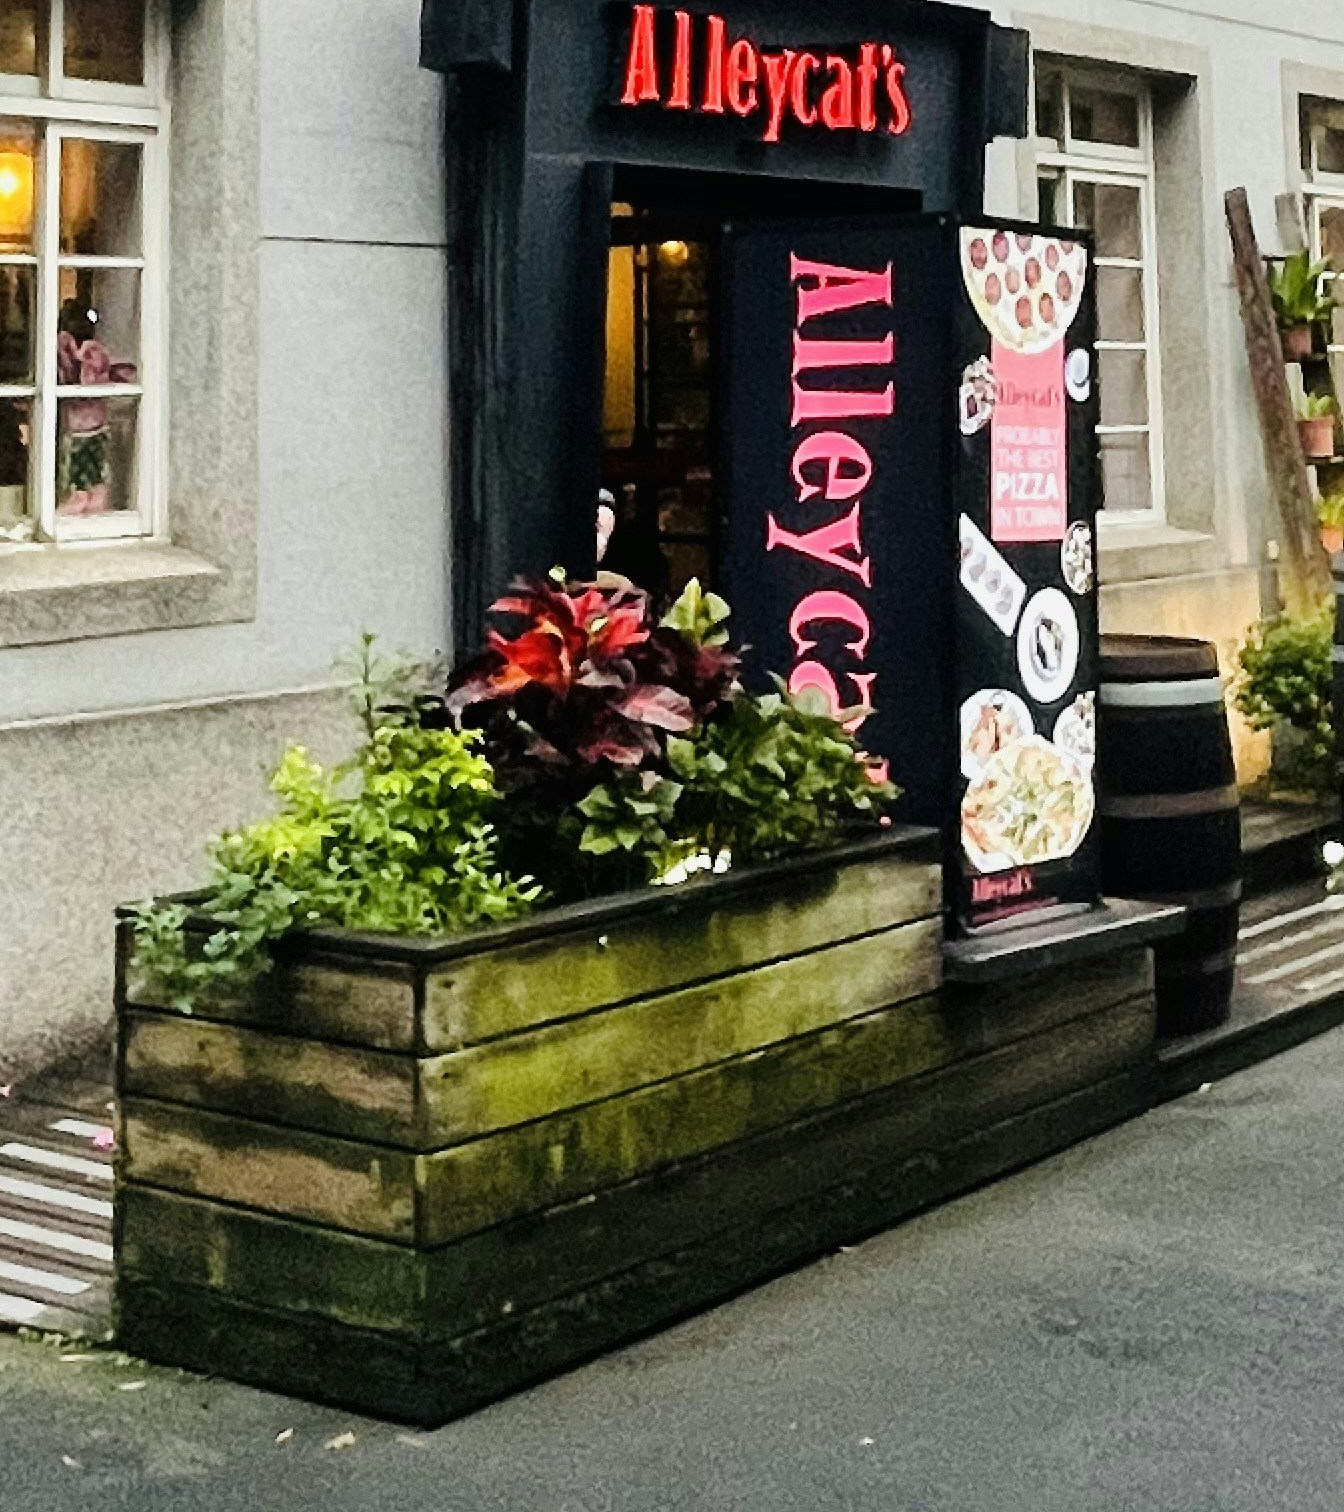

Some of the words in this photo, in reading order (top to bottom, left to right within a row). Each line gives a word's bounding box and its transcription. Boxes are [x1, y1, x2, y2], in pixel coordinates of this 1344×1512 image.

[620, 3, 912, 143] Alleycat's
[997, 448, 1024, 468] THE
[1027, 448, 1059, 469] BEST
[995, 471, 1059, 501] PIZZA
[995, 506, 1012, 527] IN
[1014, 505, 1062, 528] TOWN
